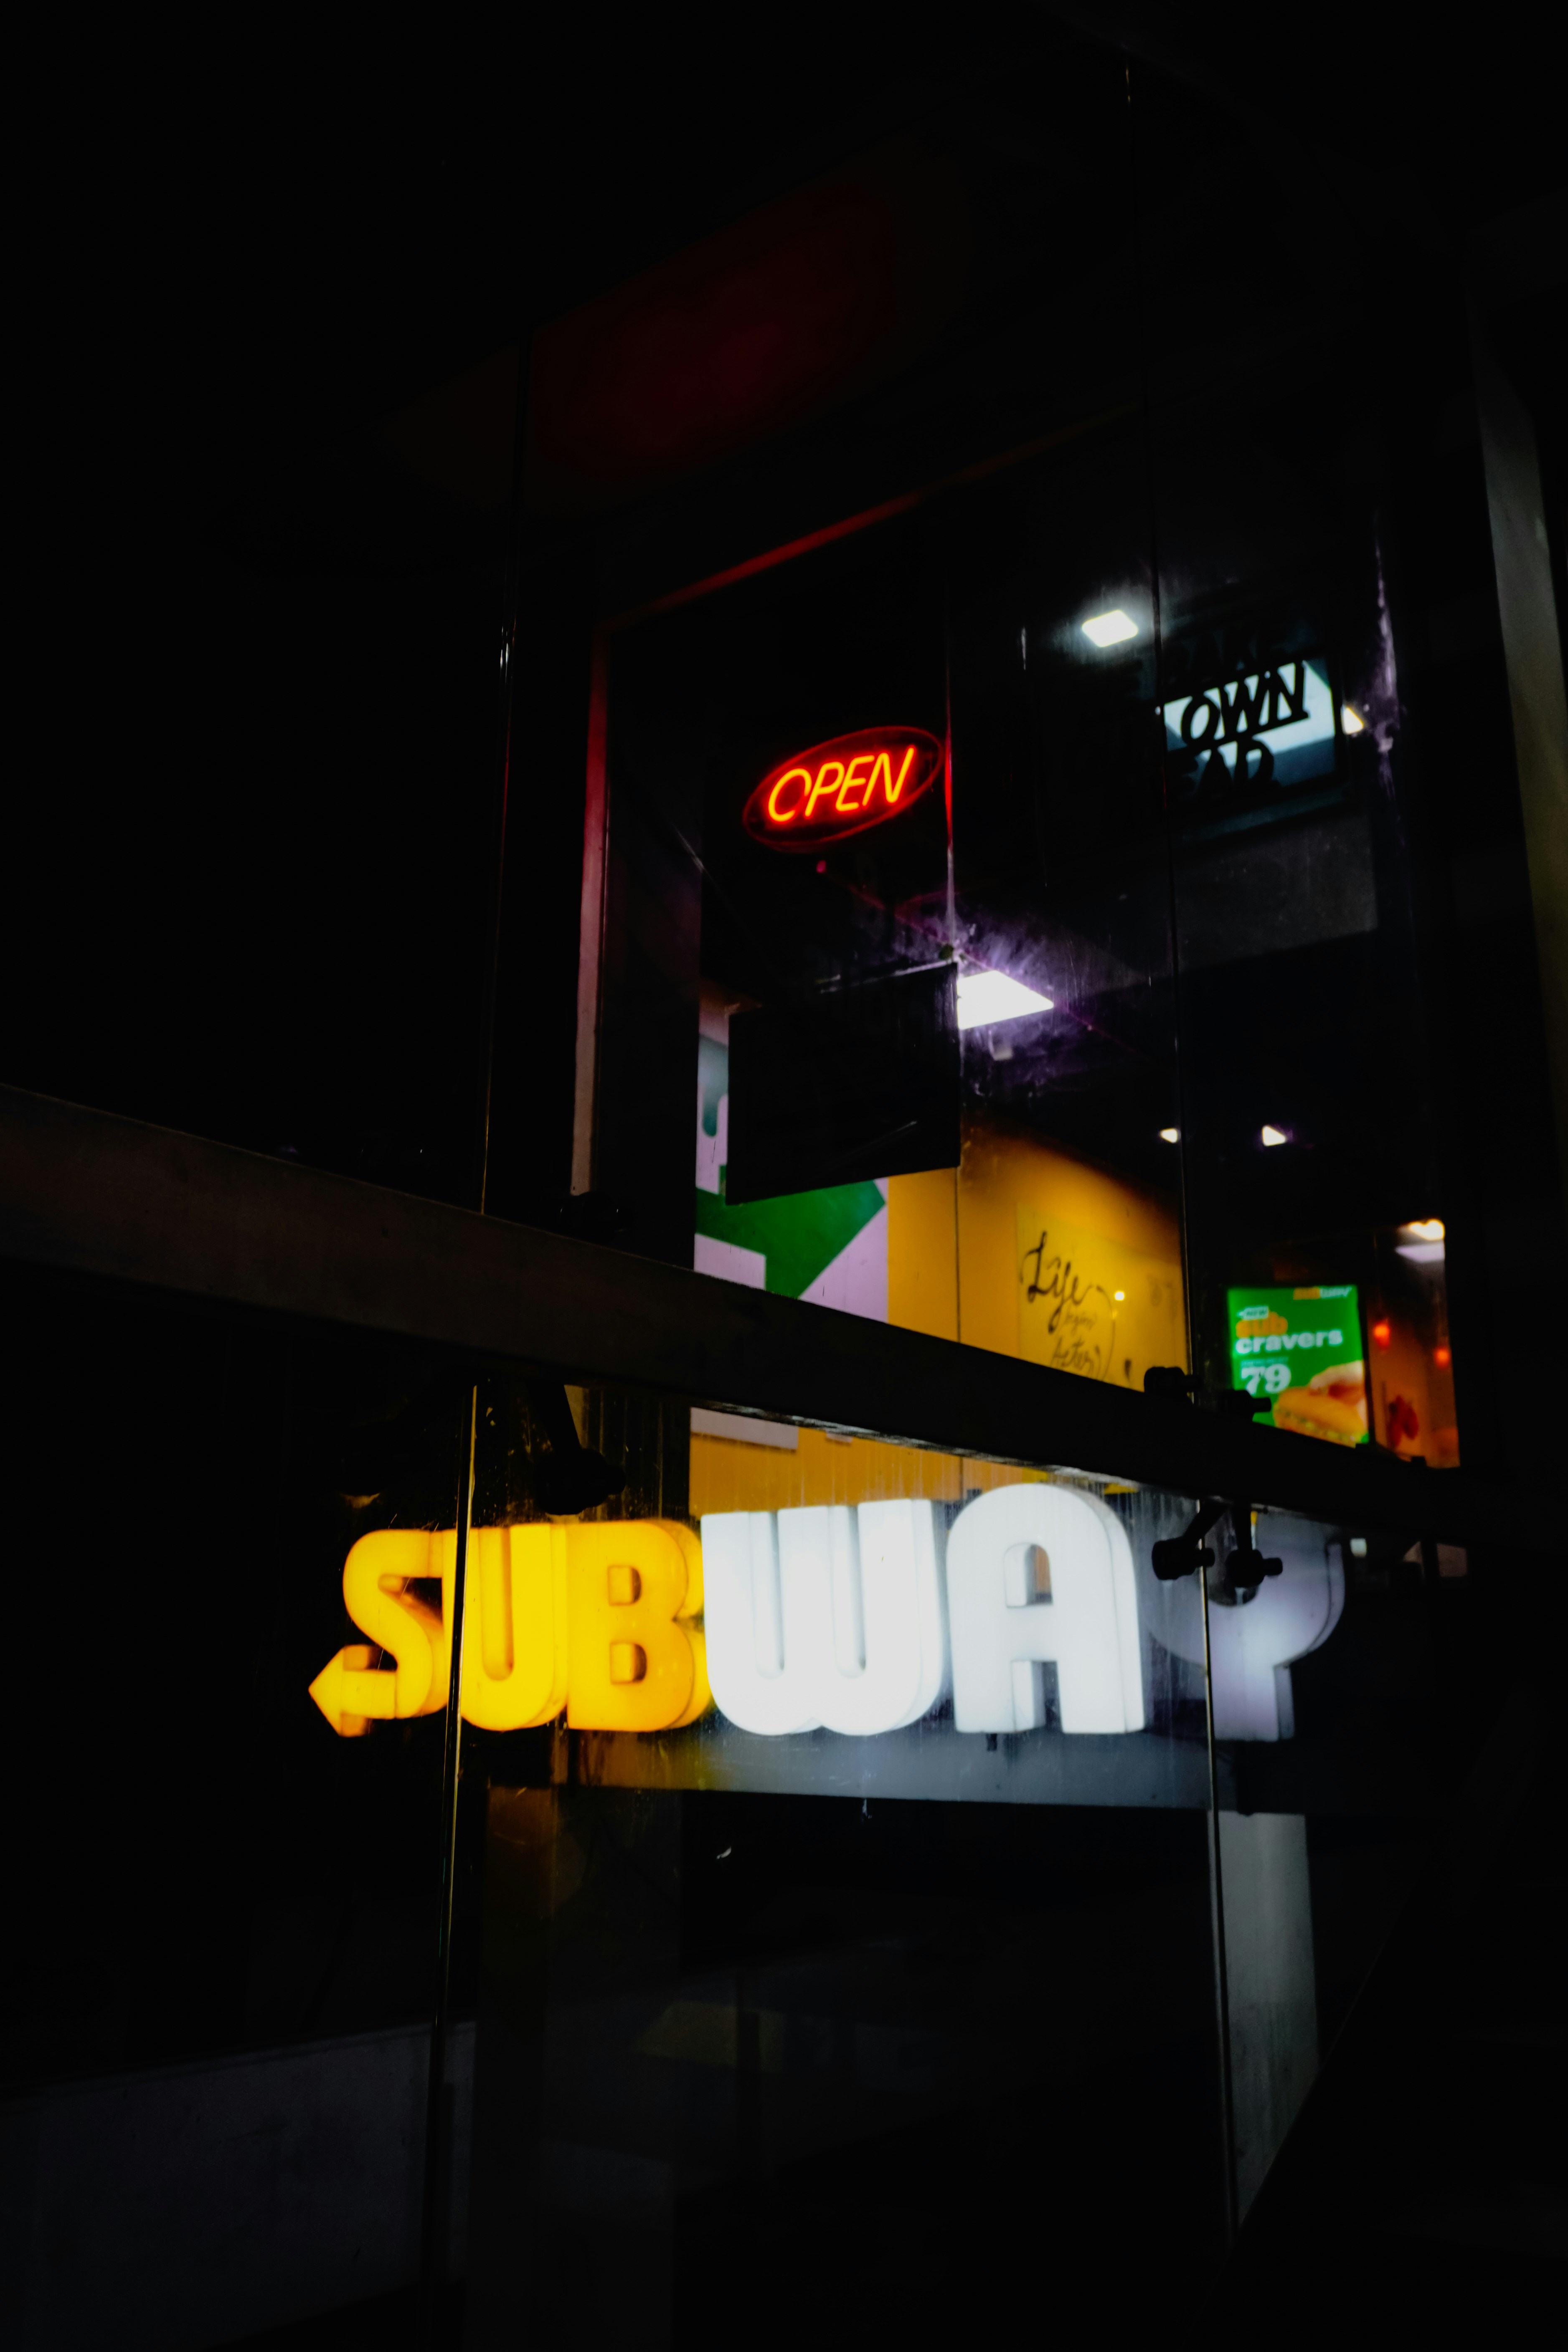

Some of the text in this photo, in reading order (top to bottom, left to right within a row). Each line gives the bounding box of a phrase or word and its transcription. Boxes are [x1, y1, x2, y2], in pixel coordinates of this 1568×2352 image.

[768, 745, 916, 823] OPEN
[1235, 1328, 1343, 1354] cravers
[1241, 1364, 1291, 1396] 79
[308, 1483, 1346, 1743] SUBWAY
